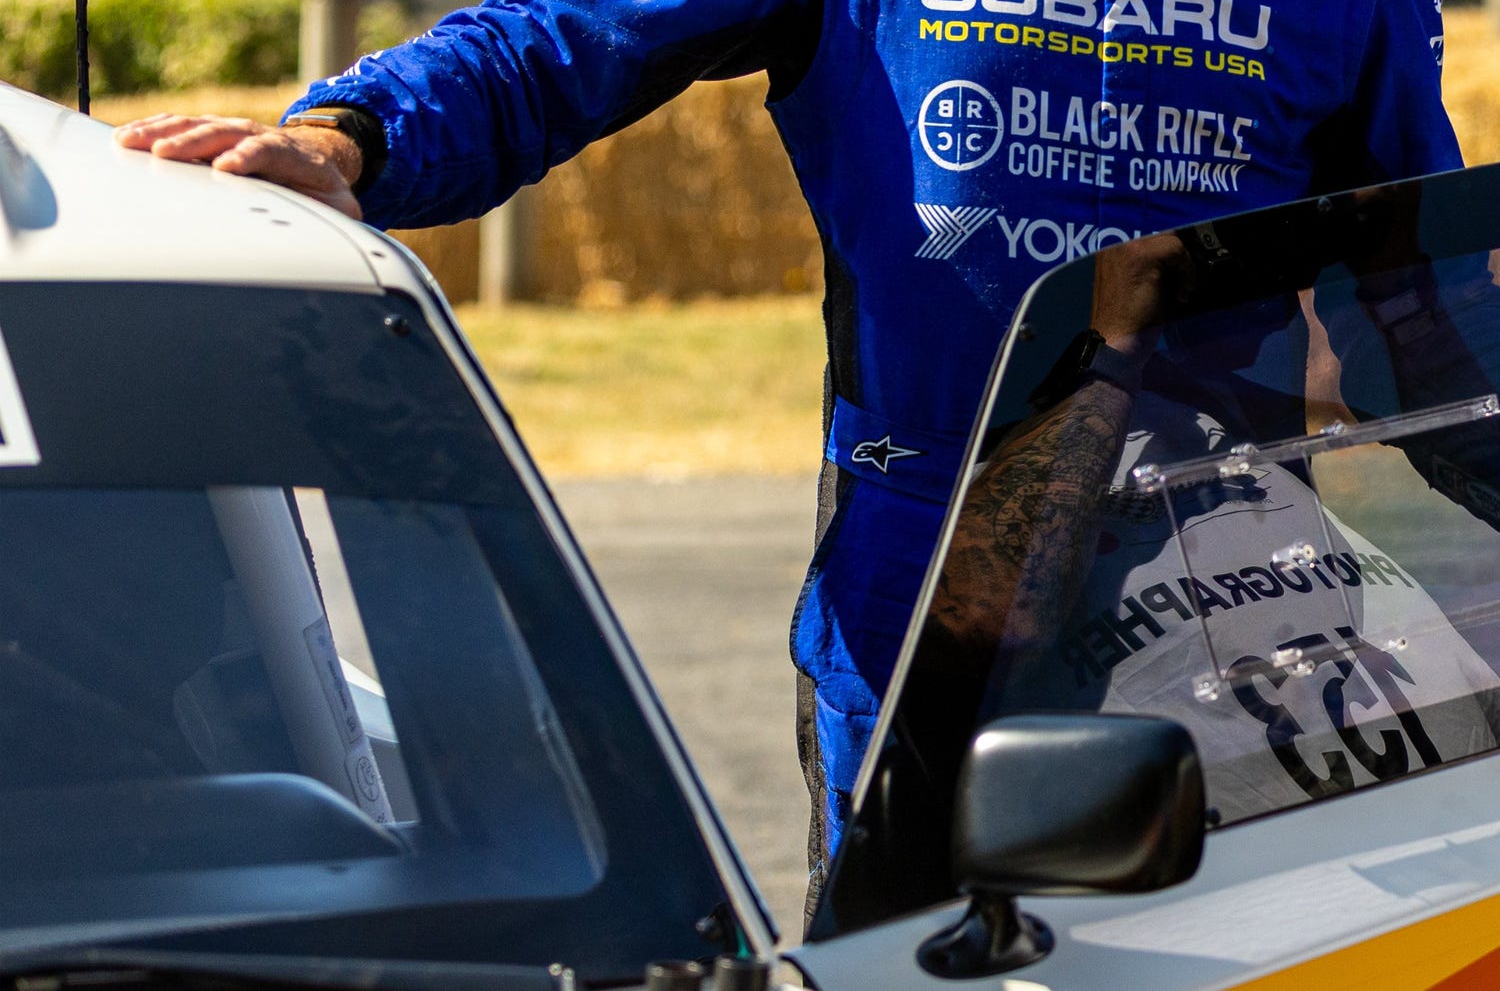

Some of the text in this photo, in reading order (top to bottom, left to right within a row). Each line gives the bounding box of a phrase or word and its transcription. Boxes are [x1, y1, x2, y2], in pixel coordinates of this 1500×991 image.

[918, 18, 1266, 81] MOTORSPORTS USA
[1010, 86, 1254, 161] BLACK RIFLE
[1007, 141, 1248, 193] COFFEE COMPANY
